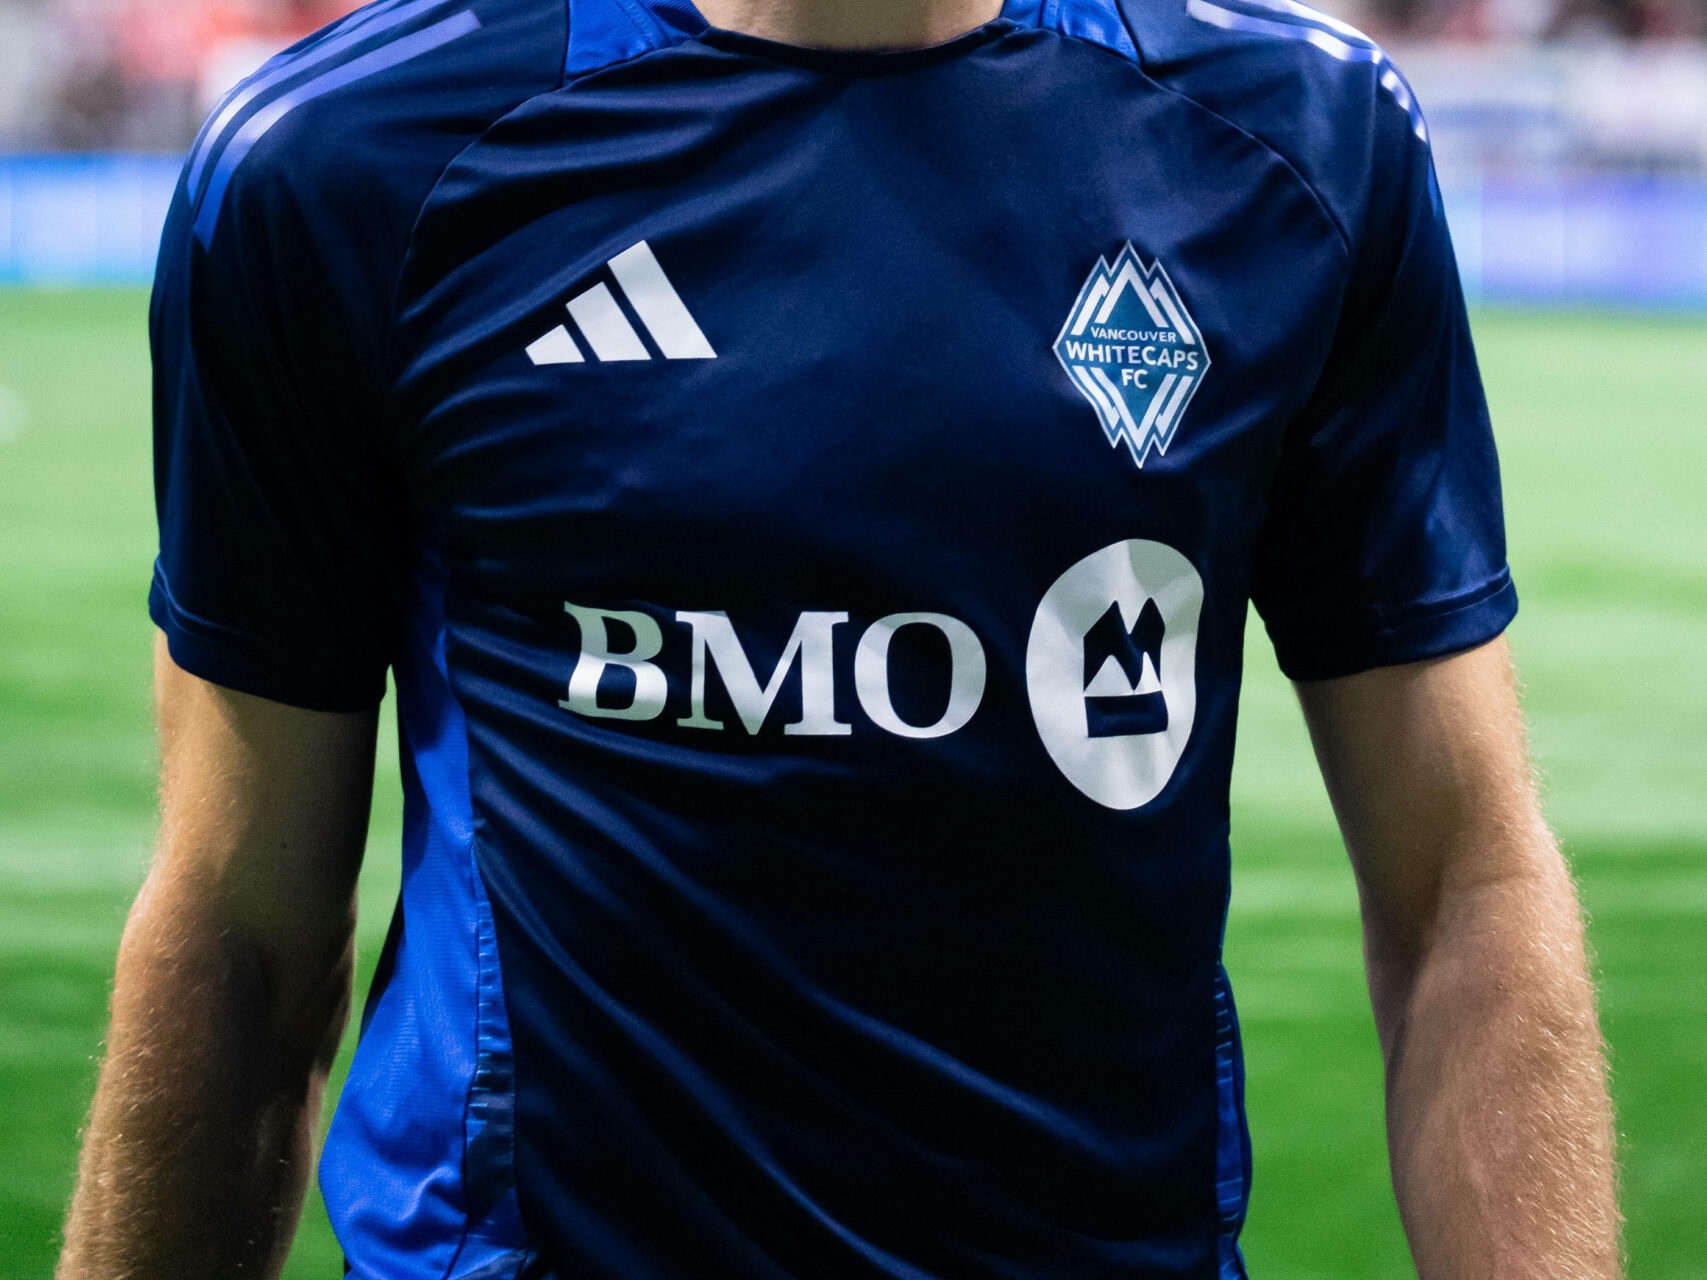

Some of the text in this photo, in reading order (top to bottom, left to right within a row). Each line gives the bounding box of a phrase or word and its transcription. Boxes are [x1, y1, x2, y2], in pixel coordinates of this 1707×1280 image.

[1091, 327, 1176, 343] VANCOUVER
[1066, 341, 1198, 370] WHITECAPS
[1121, 368, 1148, 389] FC
[558, 601, 987, 739] BMO
